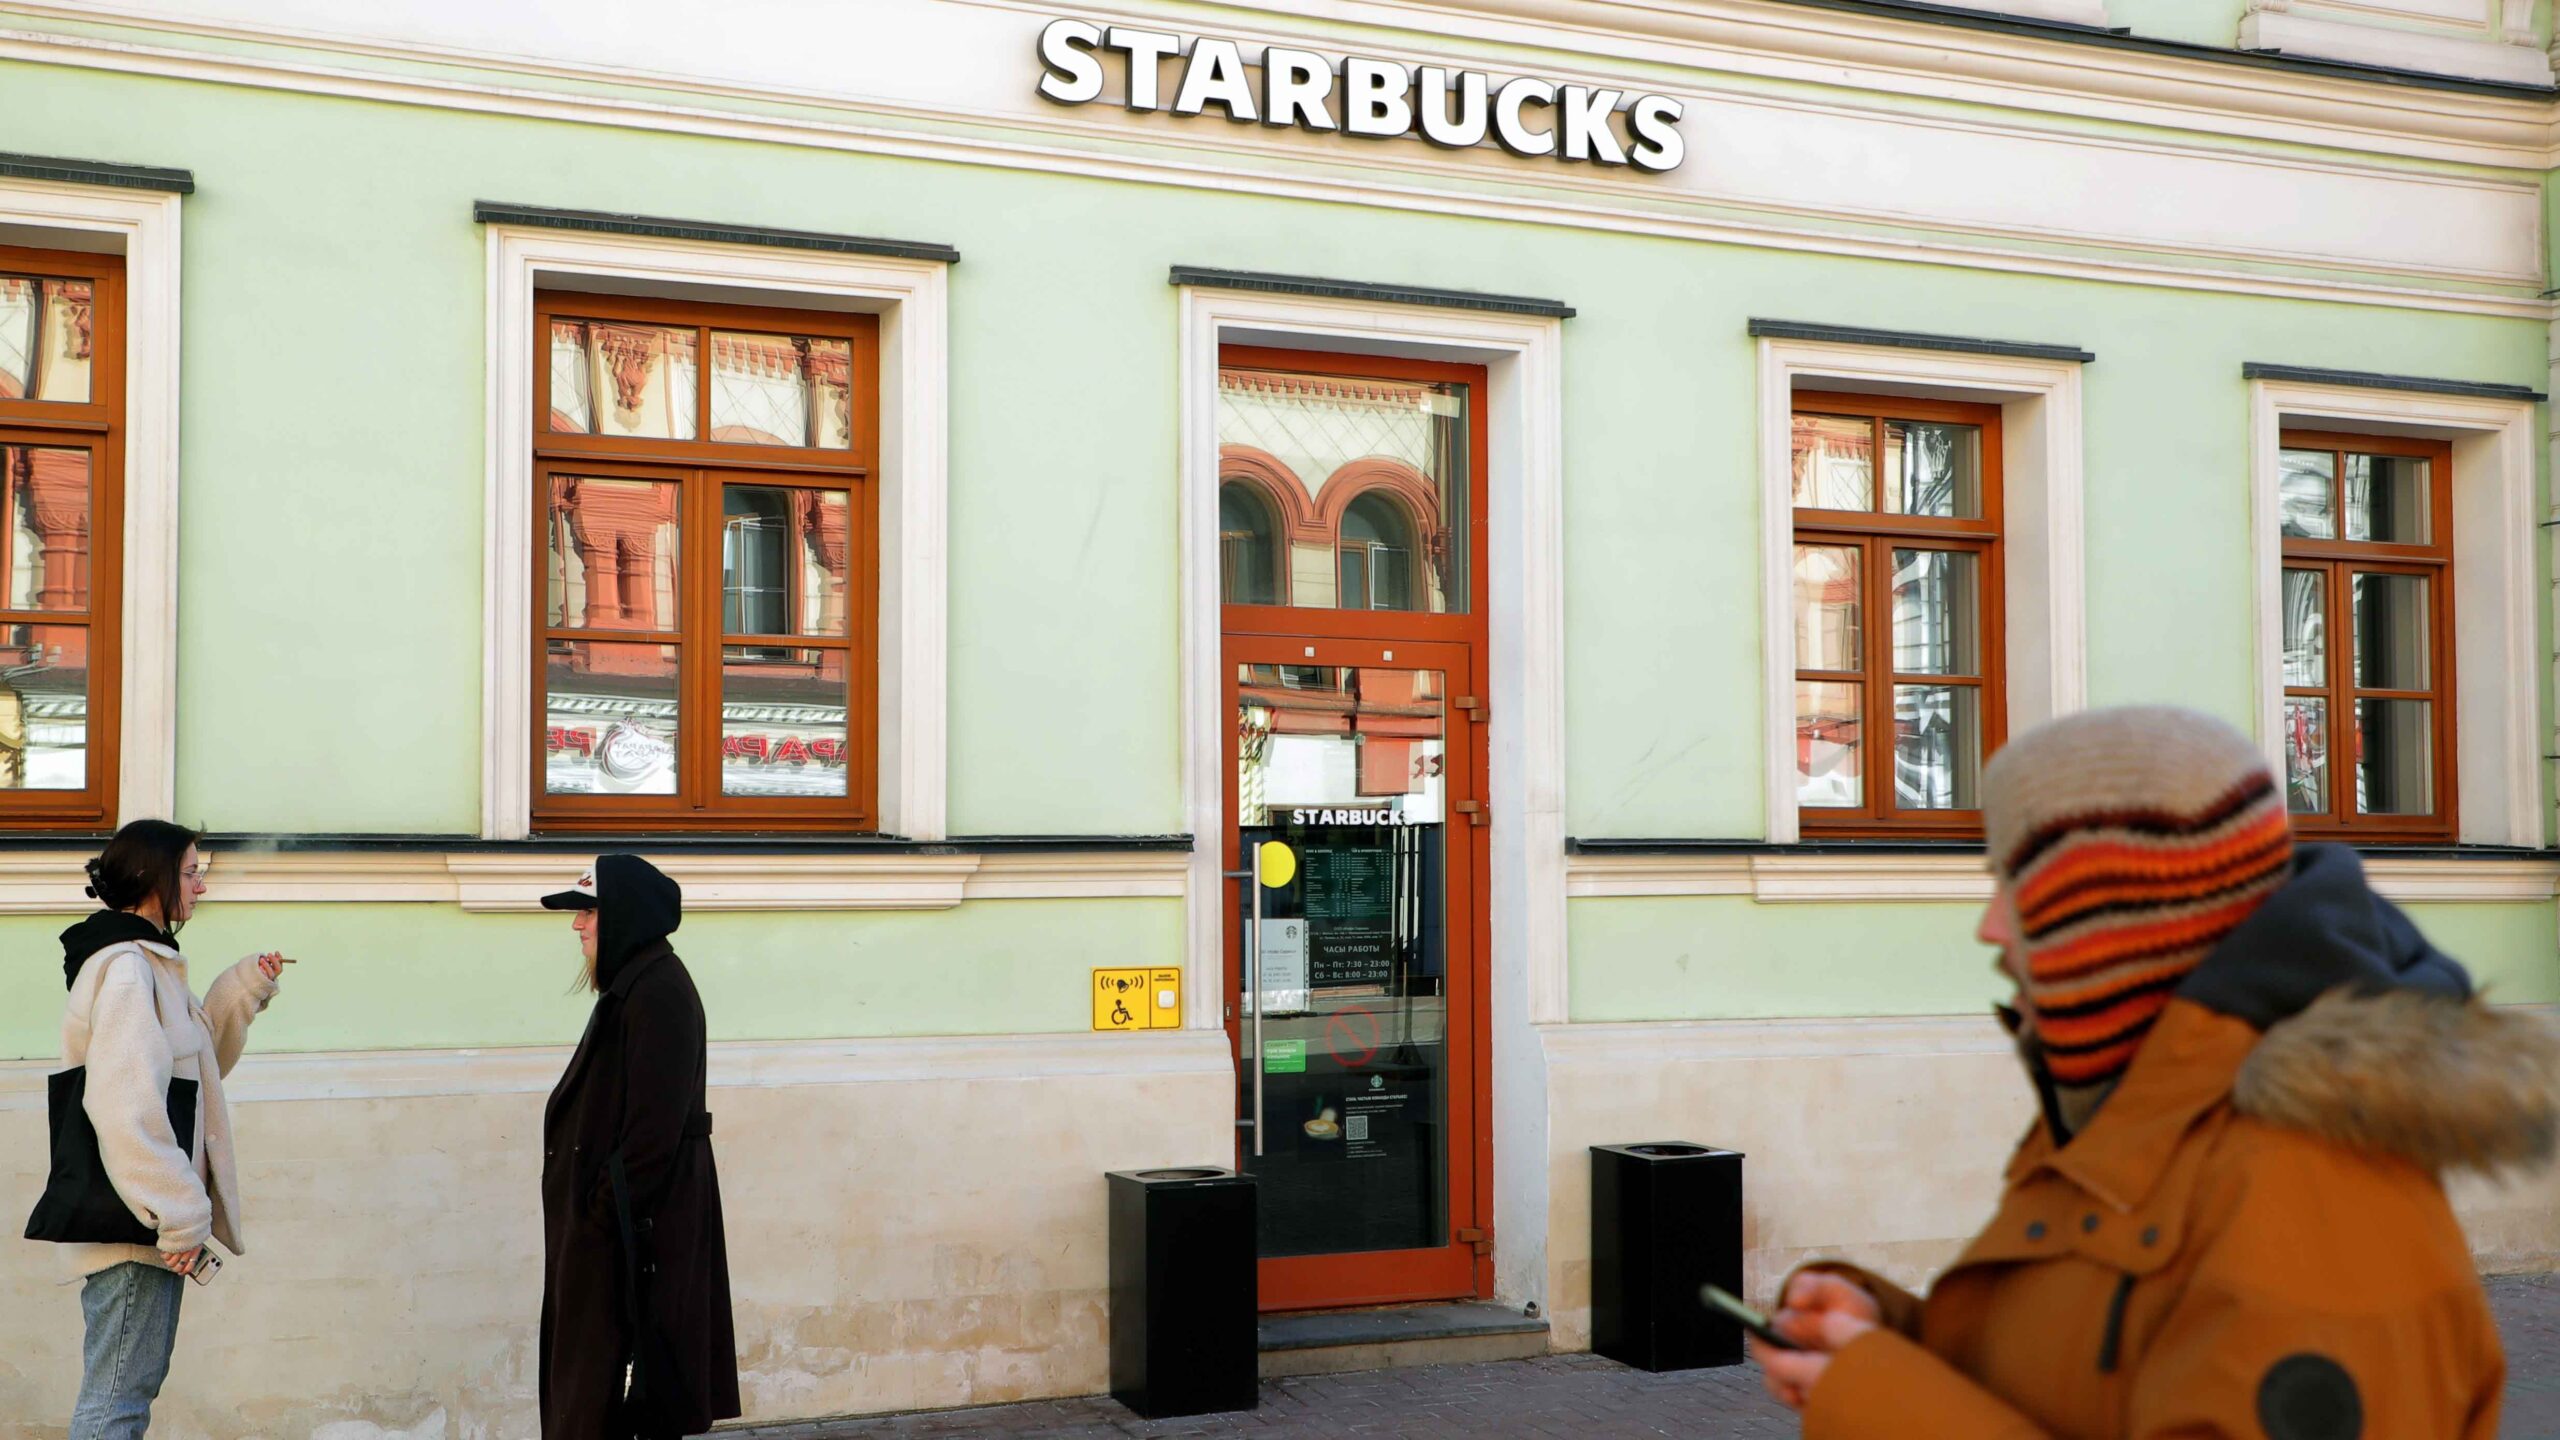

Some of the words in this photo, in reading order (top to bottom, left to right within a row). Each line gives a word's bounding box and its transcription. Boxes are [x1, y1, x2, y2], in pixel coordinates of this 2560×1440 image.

[1037, 18, 1685, 174] STARBUCKS
[1347, 945, 1380, 953] РАБОТЫ
[1313, 961, 1325, 969] Пн
[1332, 961, 1345, 969] Пт:
[1346, 960, 1362, 968] 7:30
[1370, 960, 1390, 968] 23:00
[1314, 971, 1325, 979] Сб
